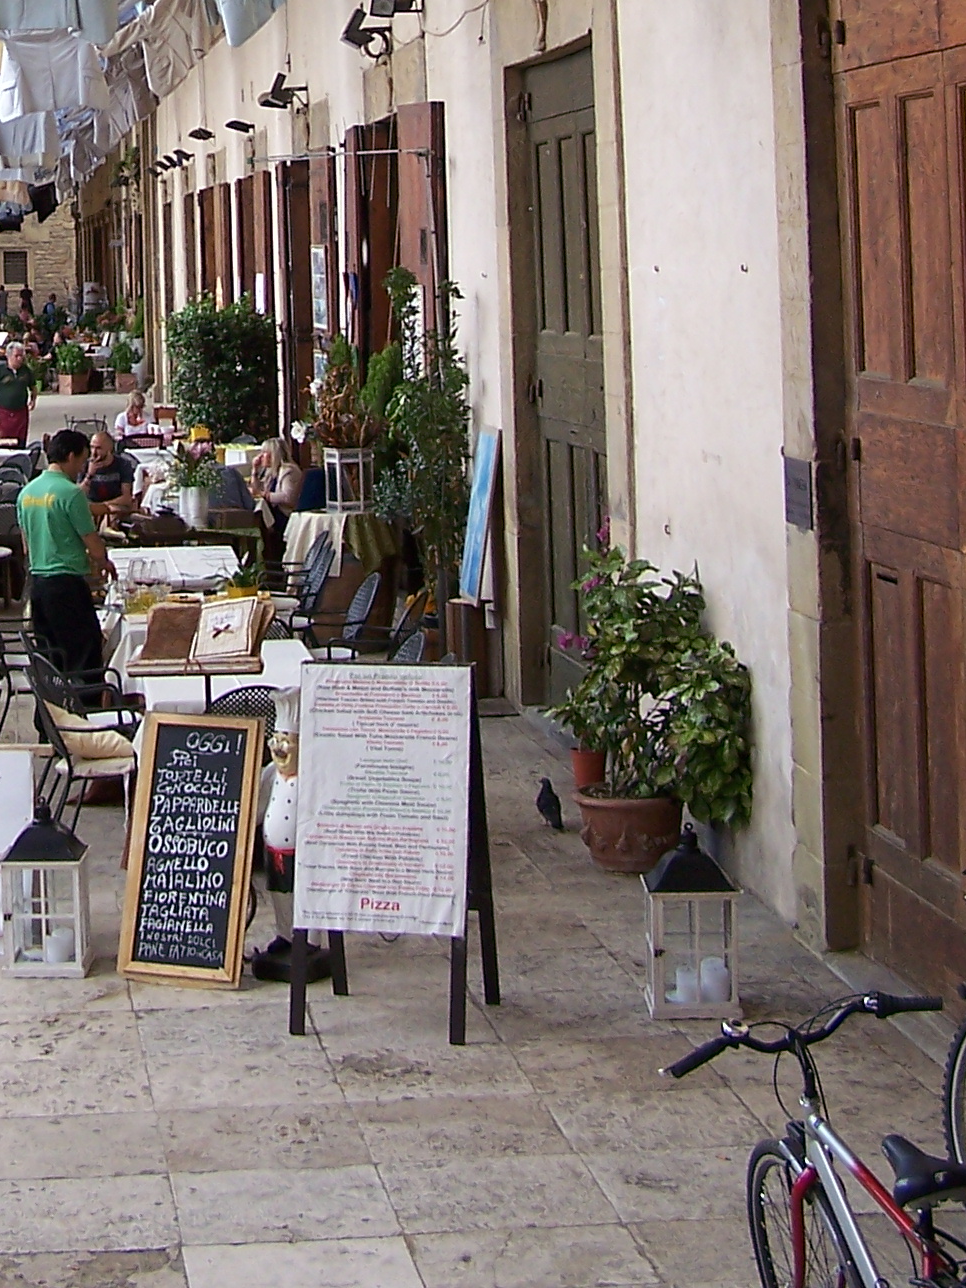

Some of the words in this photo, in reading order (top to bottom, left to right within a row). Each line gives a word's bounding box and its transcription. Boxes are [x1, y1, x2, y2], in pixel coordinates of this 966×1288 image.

[148, 834, 229, 858] OSSOBUCO
[146, 856, 209, 873] AGNELLO
[143, 872, 224, 889] MAIALINO
[360, 897, 400, 911] Pizza
